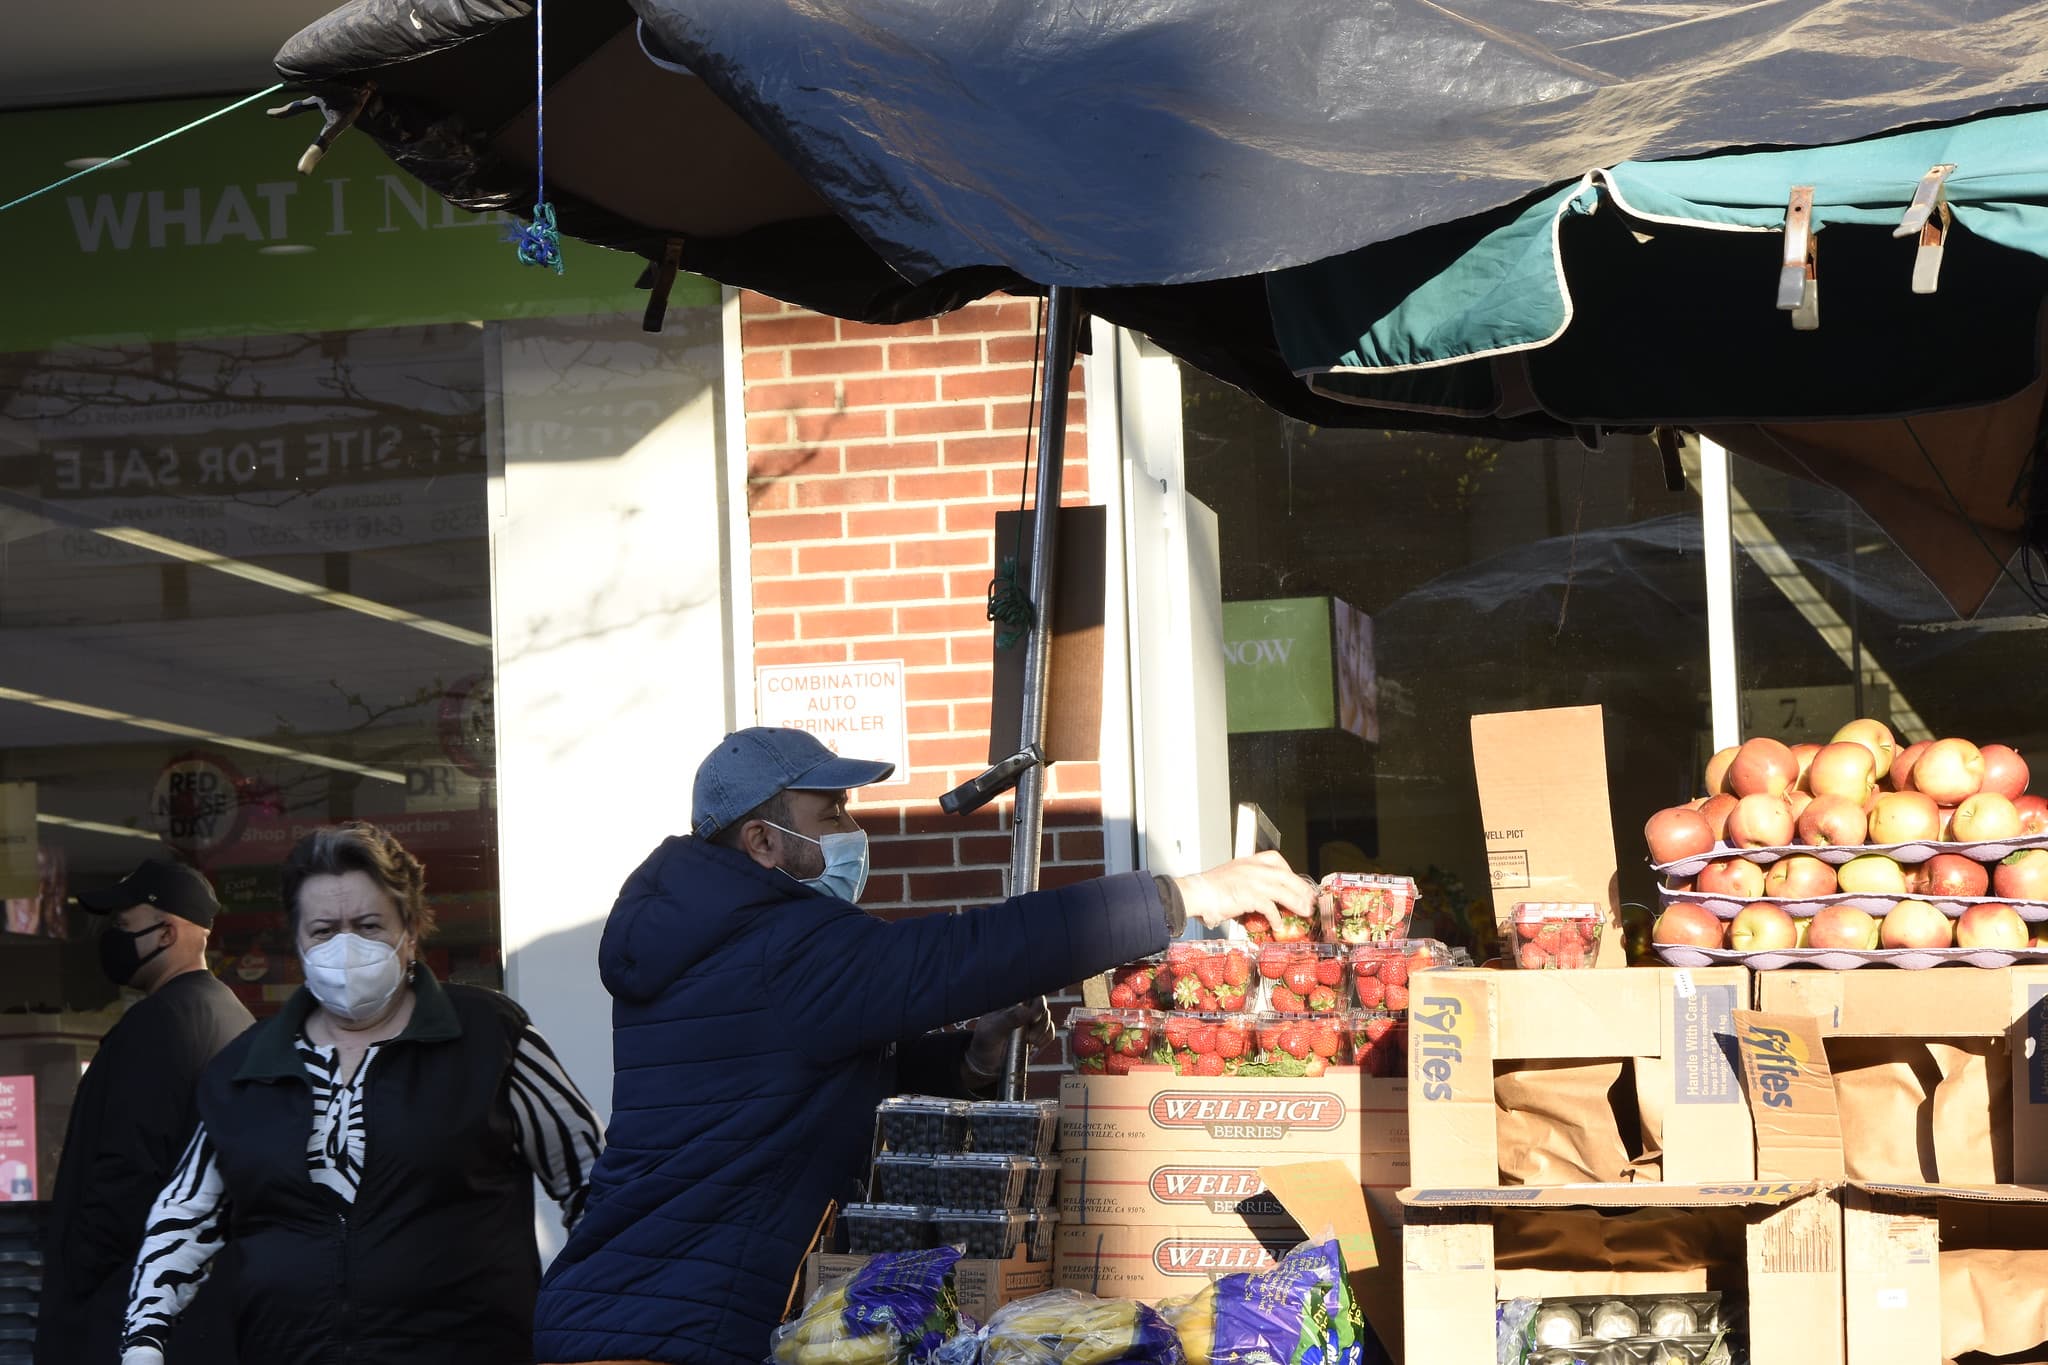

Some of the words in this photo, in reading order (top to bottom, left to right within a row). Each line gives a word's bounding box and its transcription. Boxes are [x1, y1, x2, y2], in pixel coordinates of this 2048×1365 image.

[66, 181, 299, 252] WHAT
[323, 177, 353, 236] I
[768, 672, 895, 693] COMBINATION
[808, 695, 857, 712] AUTO
[782, 715, 884, 733] SPRINKLER
[828, 738, 839, 753] &
[170, 771, 217, 792] RED
[170, 816, 215, 838] DAY
[1506, 828, 1524, 840] PICT
[1702, 1013, 1710, 1036] upside
[1686, 1024, 1699, 1052] With
[1702, 1058, 1710, 1073] drop
[1686, 1054, 1699, 1096] Handle
[1103, 1123, 1118, 1131] INC.
[1212, 1125, 1283, 1139] BERRIES
[1103, 1198, 1118, 1206] INC.
[1115, 1206, 1125, 1214] CA
[1212, 1200, 1283, 1215] BERRIES
